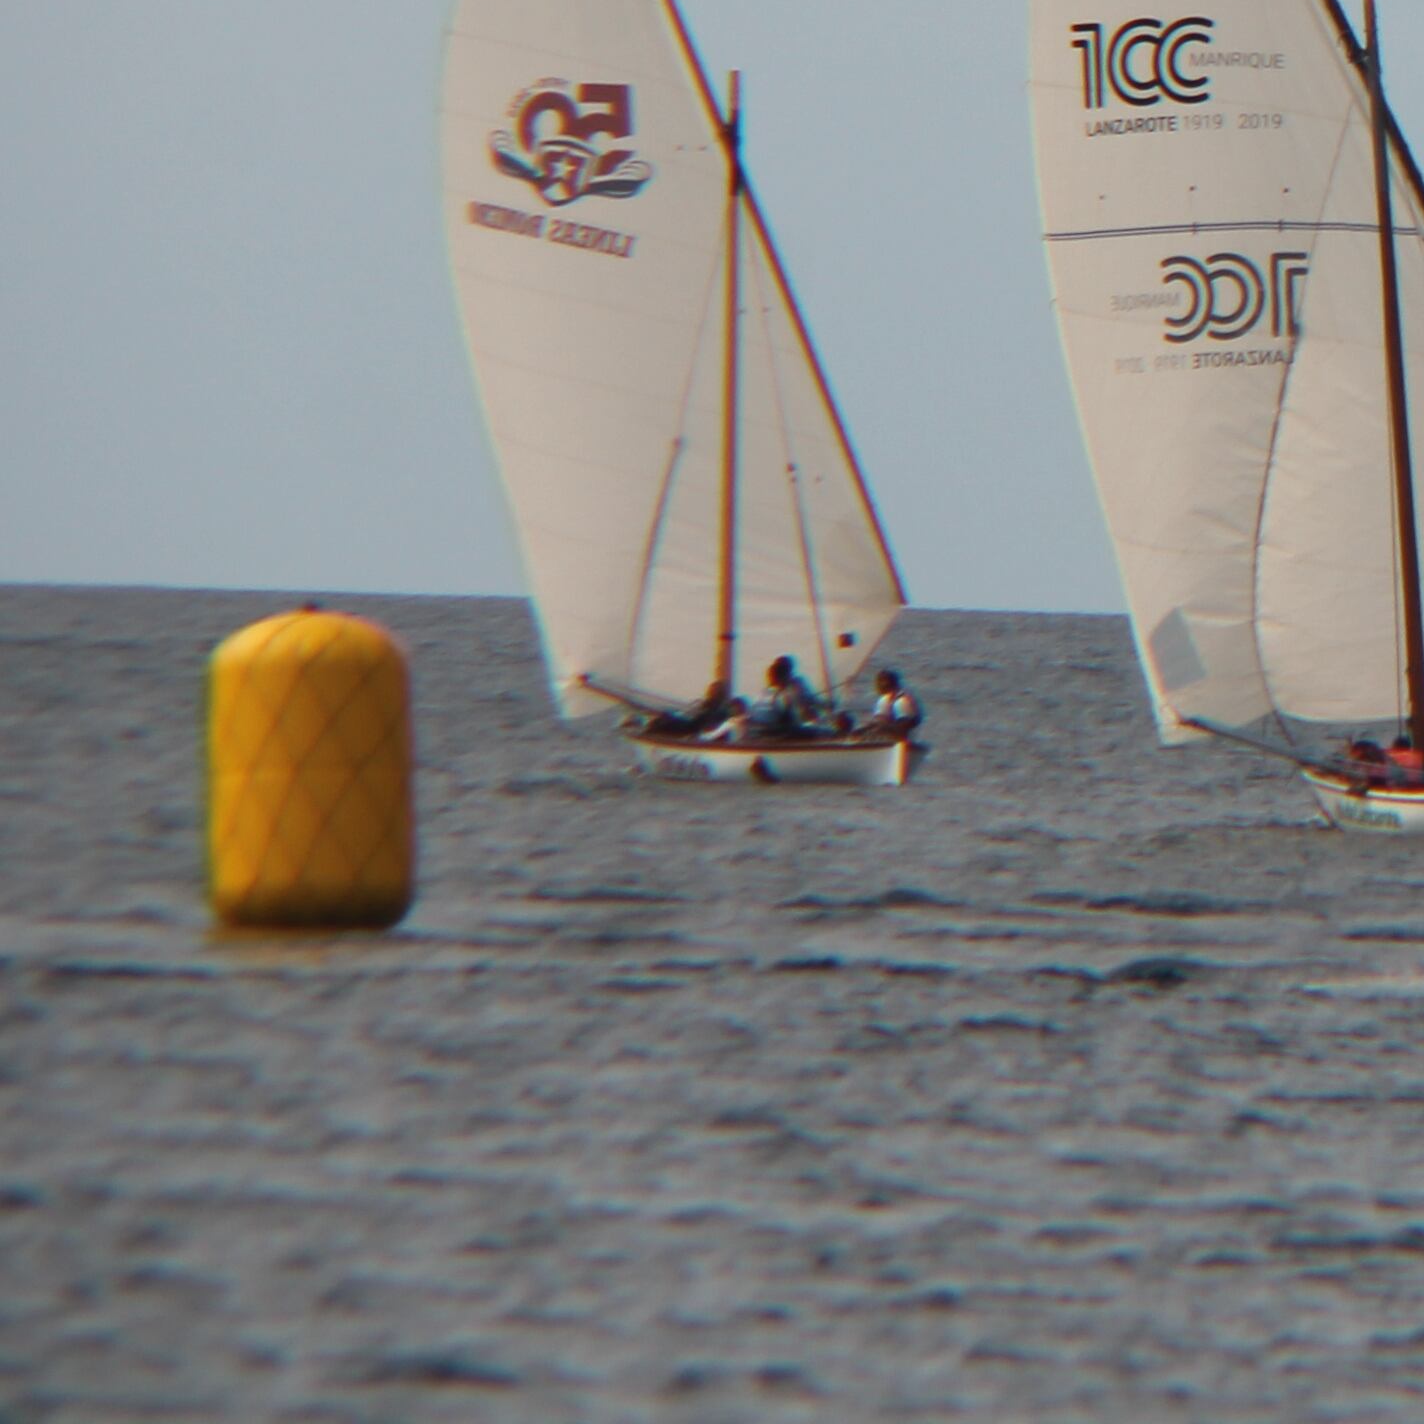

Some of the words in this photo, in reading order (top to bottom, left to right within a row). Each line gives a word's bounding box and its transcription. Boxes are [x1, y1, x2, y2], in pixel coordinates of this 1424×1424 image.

[1189, 52, 1286, 70] MANRIQUE
[1085, 114, 1179, 137] LANZAROTE
[1183, 114, 1224, 131] 1919
[1237, 113, 1283, 131] 2019
